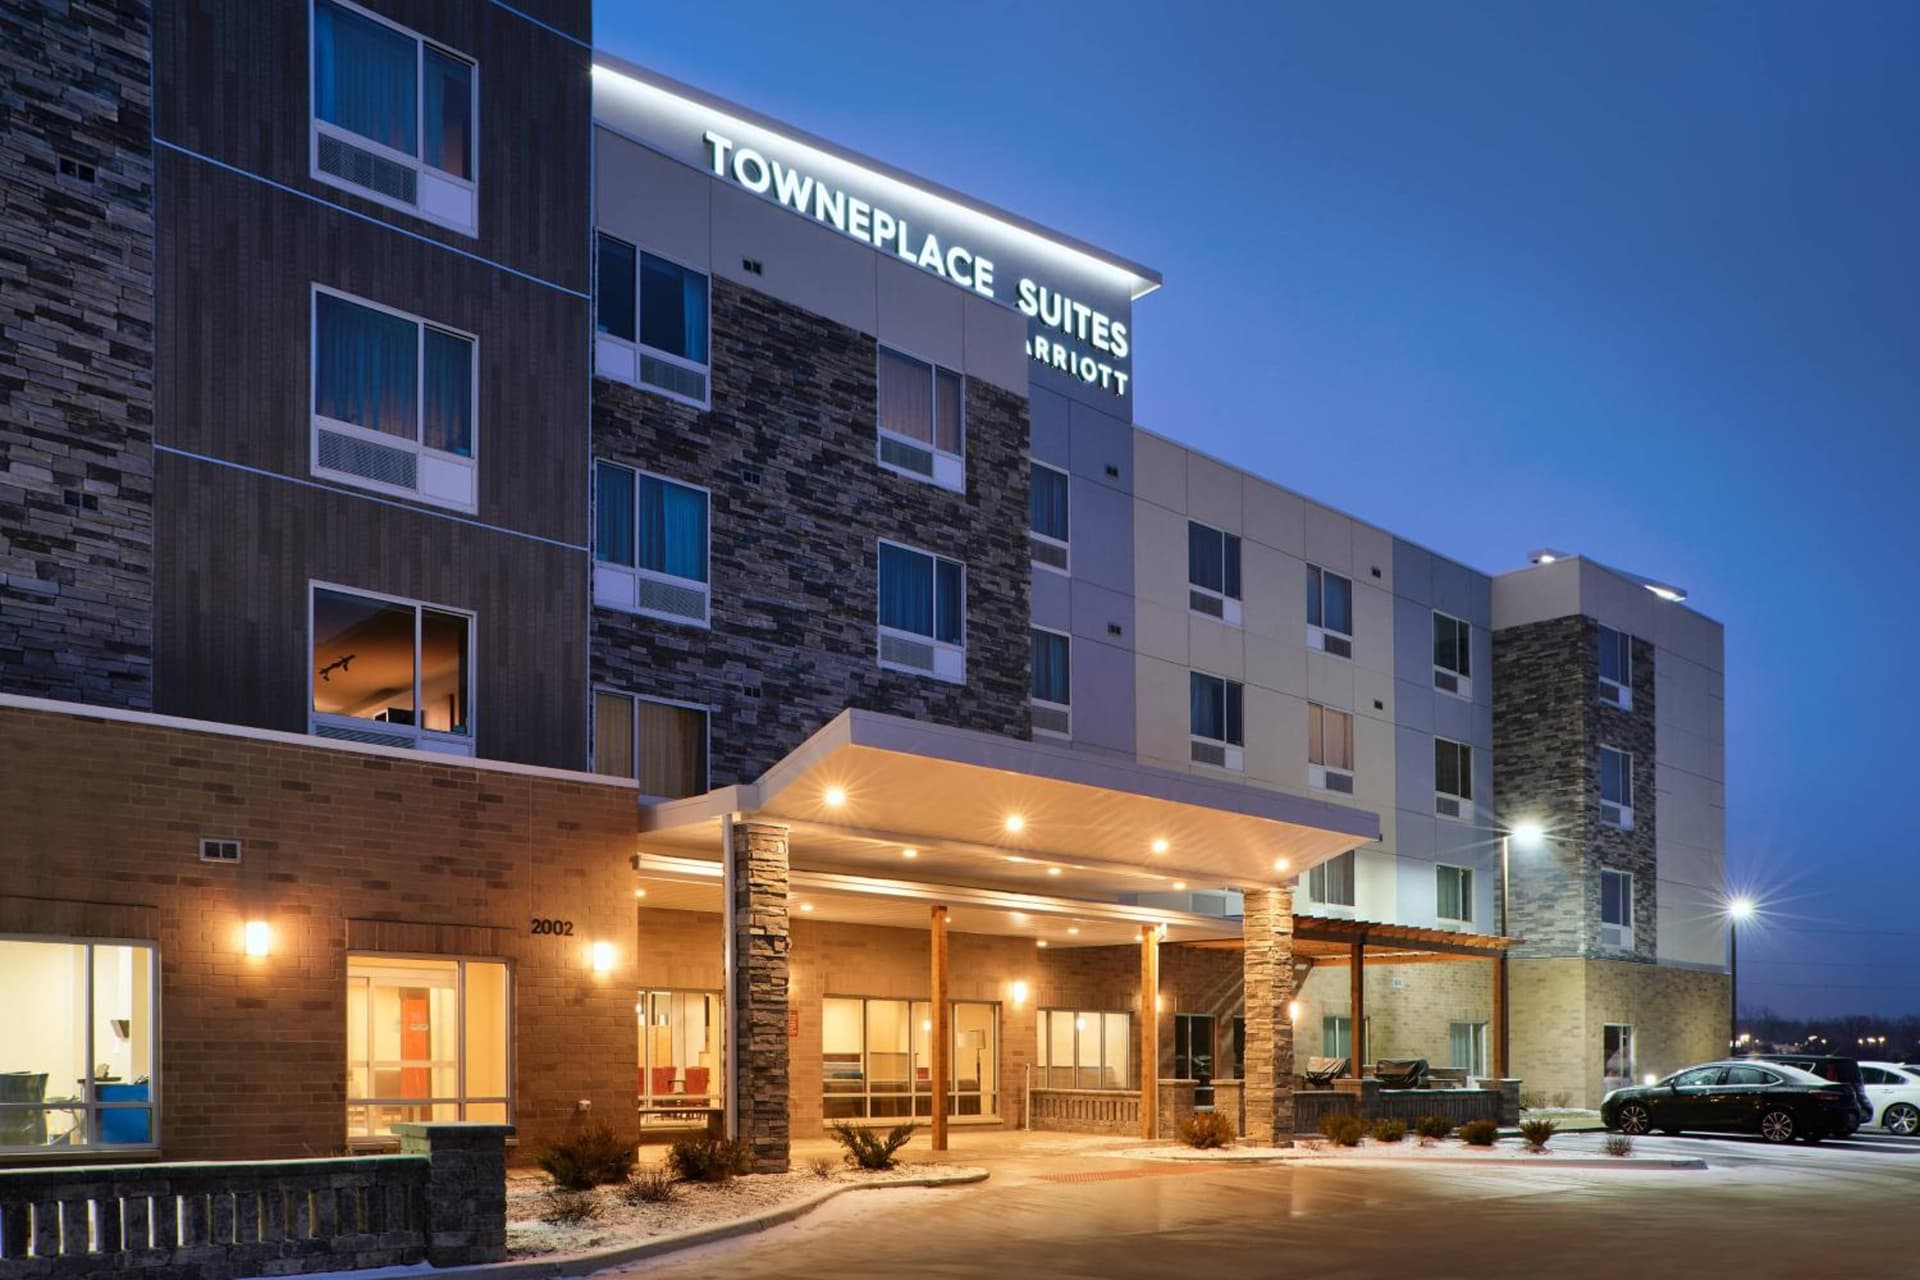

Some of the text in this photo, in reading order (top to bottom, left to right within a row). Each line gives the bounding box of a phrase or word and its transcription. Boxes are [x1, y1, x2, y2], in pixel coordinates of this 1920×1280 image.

[703, 129, 1129, 358] TOWNEPLACE SUITES
[530, 918, 575, 937] 2002
